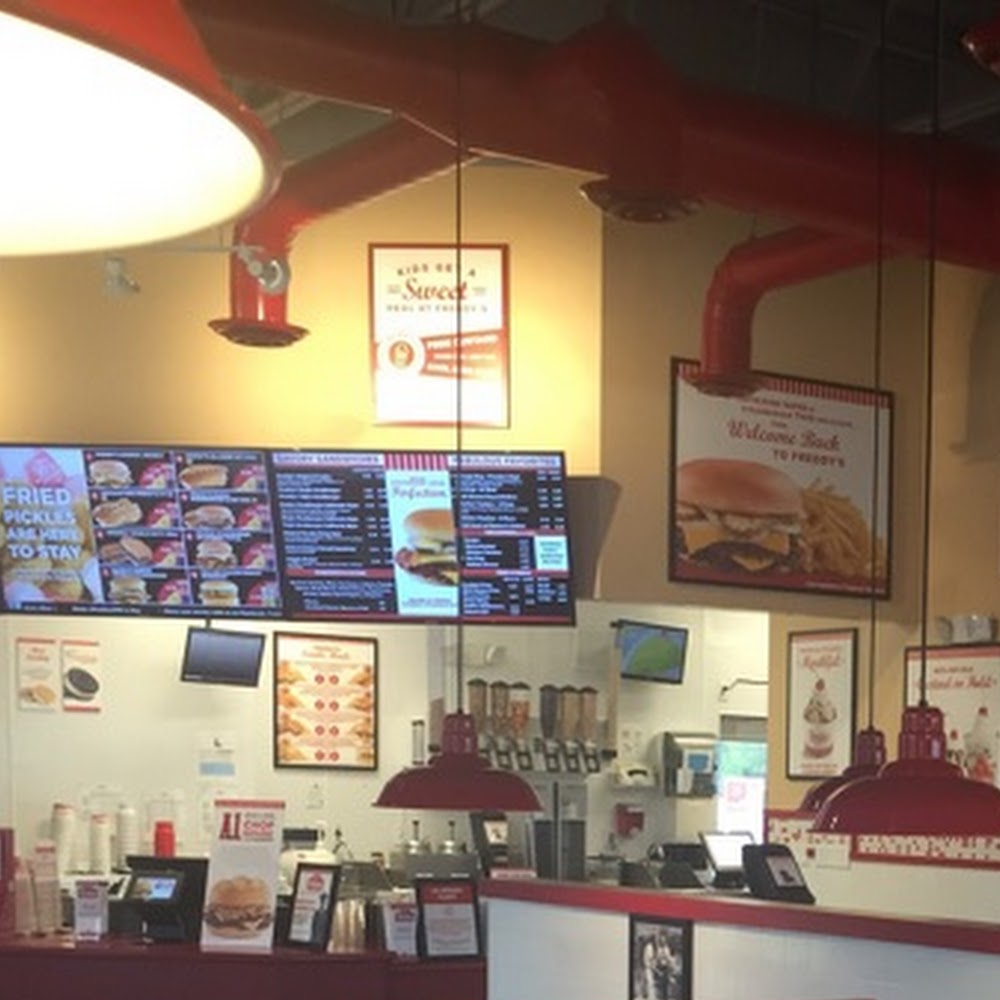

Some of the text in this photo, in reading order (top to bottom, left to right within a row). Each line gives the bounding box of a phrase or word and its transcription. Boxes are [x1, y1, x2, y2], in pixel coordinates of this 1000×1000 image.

[402, 277, 468, 301] Sweet
[727, 419, 841, 451] Welcome Back
[3, 486, 71, 505] FRIED
[3, 509, 77, 525] PICKLES
[7, 544, 82, 560] TO STAY
